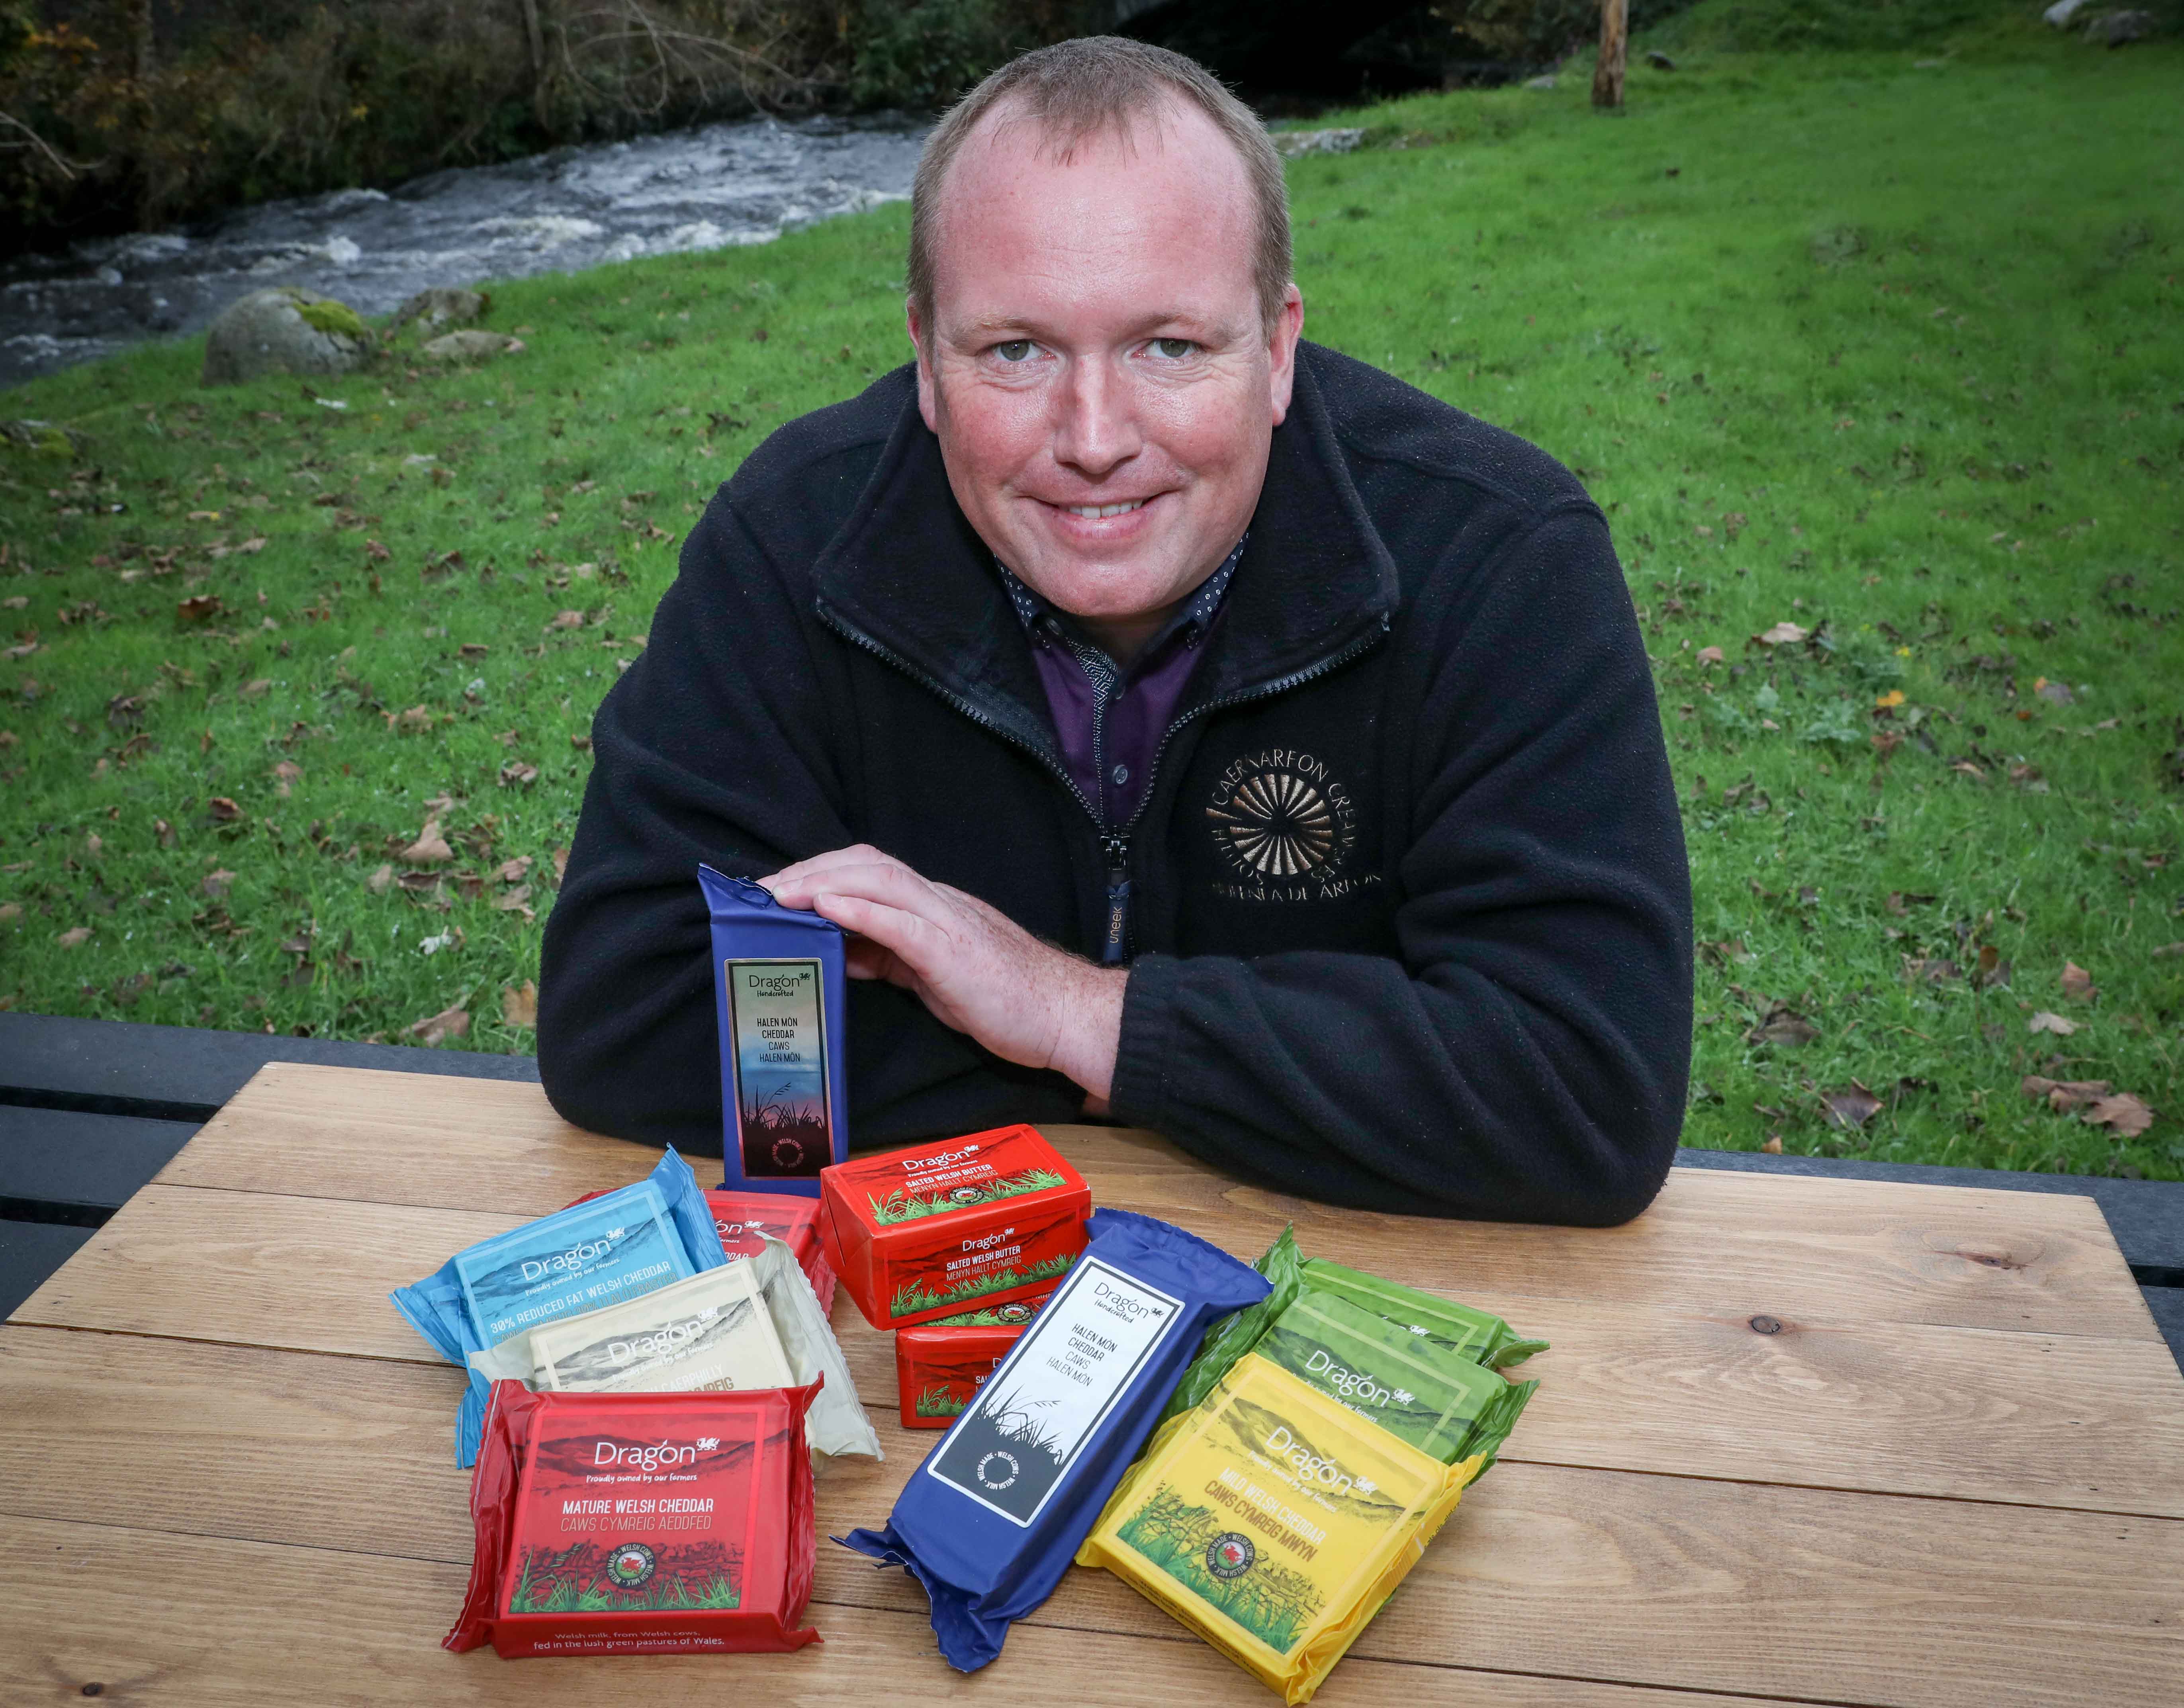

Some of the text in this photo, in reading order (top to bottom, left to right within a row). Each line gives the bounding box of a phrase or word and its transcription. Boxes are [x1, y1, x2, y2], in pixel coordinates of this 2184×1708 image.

[1109, 907, 1122, 943] uneek
[749, 973, 800, 991] Dragon
[757, 1017, 798, 1026] HALEN MÔN
[762, 1030, 795, 1038] CHEDDAR
[769, 1042, 789, 1050] CAWS
[759, 1052, 800, 1062] HALEN MÔN
[902, 1151, 970, 1170] Dragon
[905, 1164, 993, 1187] SALTED WELSH BUTTER
[910, 1169, 998, 1193] MENYN HALLT CYMREIG
[963, 1233, 1005, 1252] Dragon
[521, 1240, 612, 1281] Dragon
[947, 1245, 1020, 1271] SALTED WELSH BUTTER
[947, 1255, 1022, 1281] MENYN HALLT CYMREIG
[525, 1283, 551, 1296] Proudly
[552, 1275, 572, 1286] owned
[596, 1258, 620, 1269] farmers
[491, 1261, 671, 1333] 30% REDUCED FAT WELSH CHEDDAR
[1094, 1282, 1149, 1318] Dragon
[1094, 1299, 1134, 1323] Handcrafted
[608, 1320, 705, 1364] Dragon
[1068, 1337, 1104, 1361] CHEDDAR
[1072, 1323, 1117, 1352] HALEN MÔN
[612, 1367, 639, 1382] Proudly
[641, 1358, 662, 1371] owned
[664, 1353, 674, 1363] by
[687, 1343, 714, 1355] farmers
[1046, 1357, 1093, 1387] HALEN MÔN
[1065, 1351, 1090, 1369] CAWS
[661, 1364, 723, 1392] CAERPHILLY
[1305, 1350, 1390, 1407] Dragon
[595, 1439, 696, 1471] Dragon
[980, 1452, 994, 1465] MADE
[998, 1451, 1019, 1475] WELSH COWS
[1265, 1426, 1352, 1495] Dragon
[586, 1473, 615, 1484] Proudly
[643, 1473, 653, 1483] by
[985, 1477, 1016, 1490] WELSH MILK
[1249, 1450, 1337, 1512] Proudly owned by our farmers
[562, 1498, 714, 1514] MATURE WELSH CHEDDAR
[1219, 1467, 1326, 1544] MILD WELSH CHEDDAR
[561, 1516, 712, 1532] CAWS CYMREIG AEDDFED
[1204, 1480, 1318, 1562] CAWS CYMREIG MWYN
[620, 1544, 654, 1560] WELSH COWS
[1207, 1535, 1228, 1566] WELSH MADE
[1233, 1534, 1254, 1561] WELSH COWS
[607, 1551, 622, 1584] WELSH MADE
[626, 1564, 654, 1587] WELSH MILK
[1214, 1564, 1248, 1577] WELSH MILK
[637, 1639, 677, 1648] pastures
